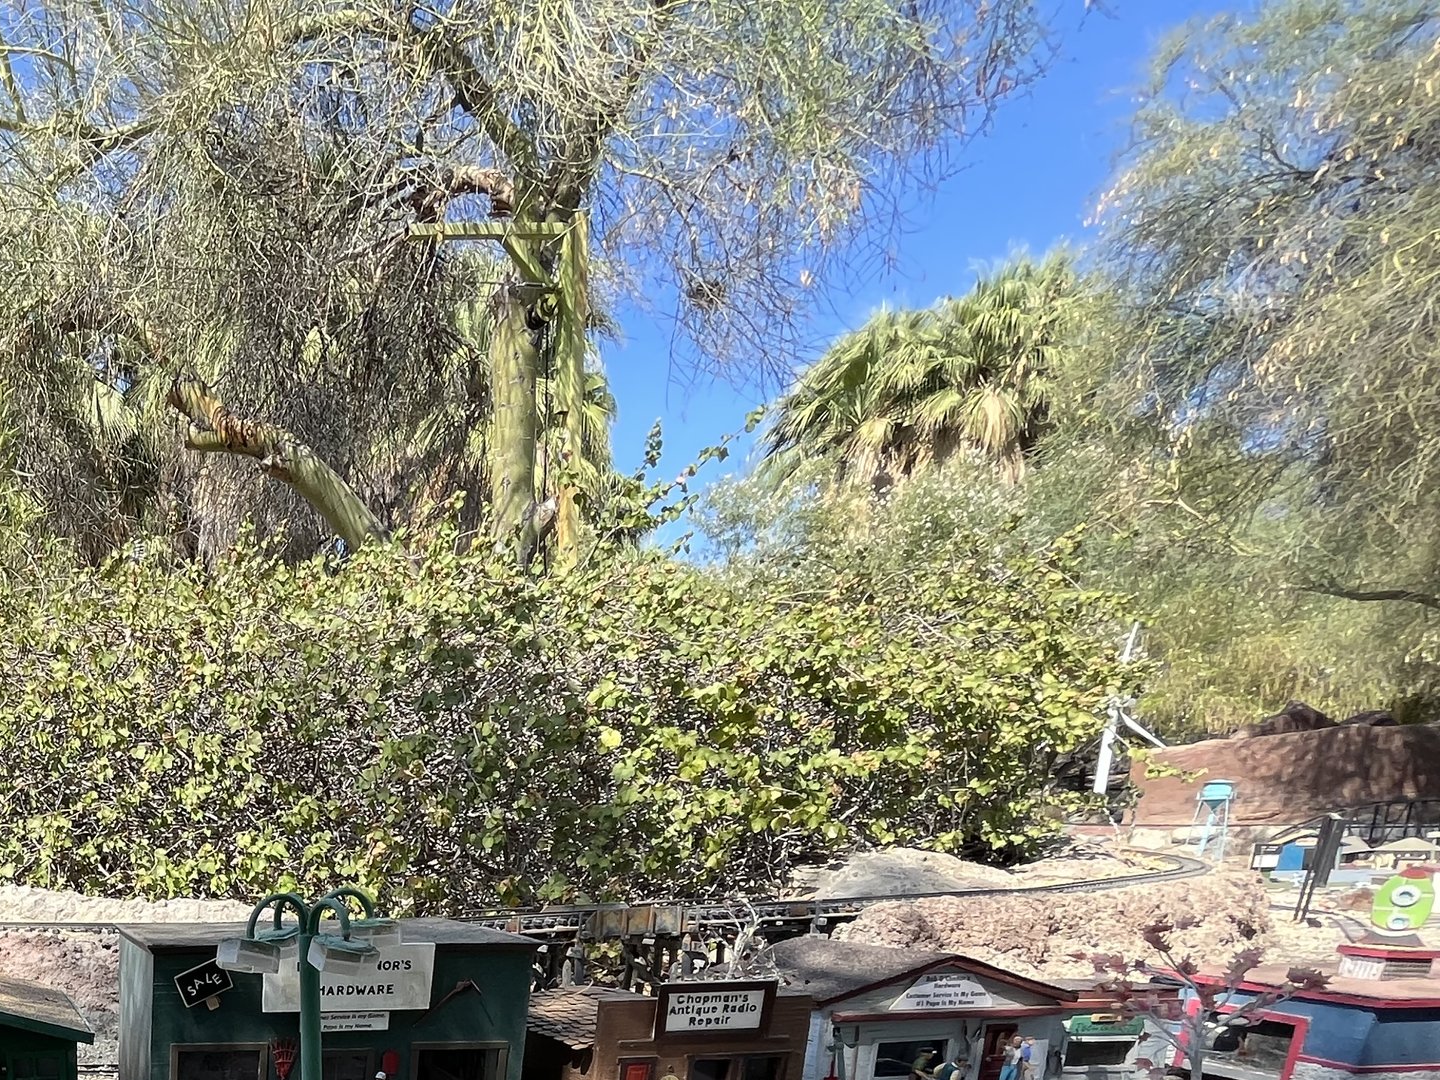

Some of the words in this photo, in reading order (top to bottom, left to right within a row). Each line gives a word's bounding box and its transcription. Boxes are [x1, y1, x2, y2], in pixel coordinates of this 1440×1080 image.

[187, 972, 223, 996] SALE
[677, 993, 749, 1006] Chapman's
[669, 1005, 718, 1016] Antique
[722, 1003, 757, 1014] Radio
[688, 1015, 731, 1027] Repair
